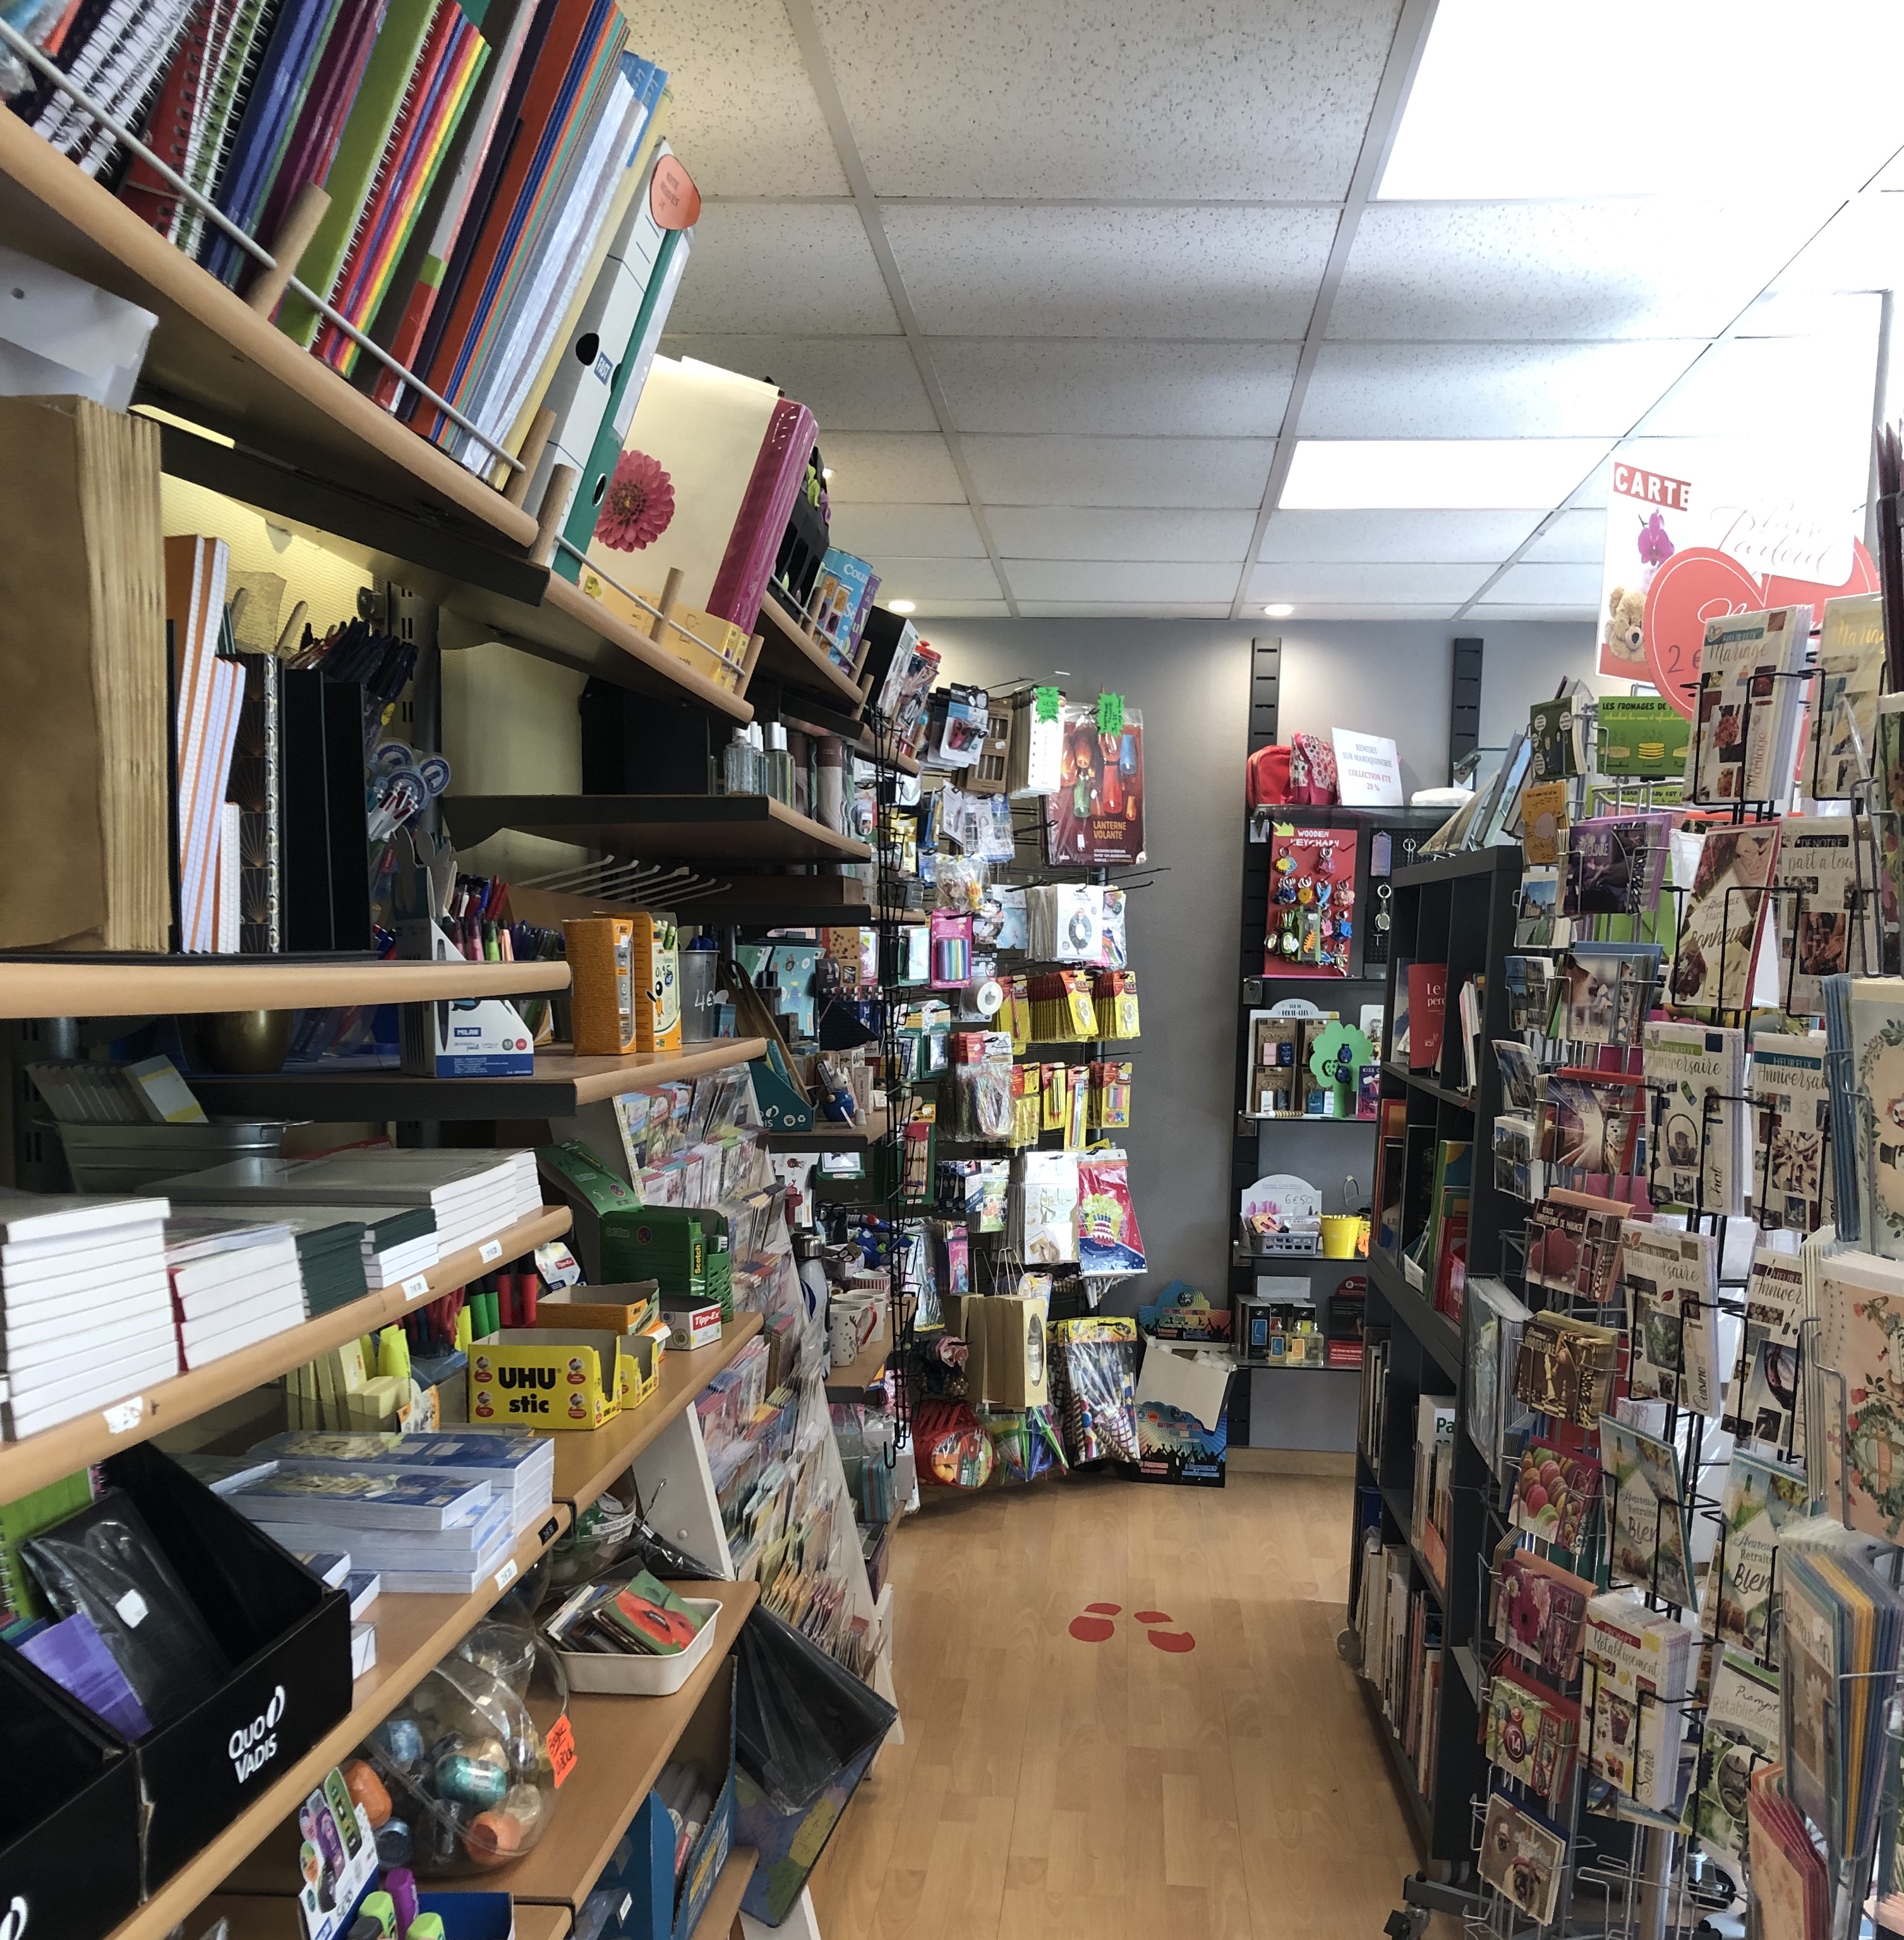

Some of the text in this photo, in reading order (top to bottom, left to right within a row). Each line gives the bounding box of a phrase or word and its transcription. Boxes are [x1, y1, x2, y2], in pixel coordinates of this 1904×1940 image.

[598, 355, 611, 379] FAST
[1615, 466, 1691, 510] CARTE
[1668, 645, 1684, 673] 2
[1709, 642, 1768, 663] Mariage
[1356, 744, 1377, 754] REMISES
[1342, 752, 1392, 768] SUR MAROQUINERIE
[1746, 732, 1768, 788] Mariage
[1348, 769, 1381, 781] COLLECTION
[1094, 821, 1126, 830] LANTERNE
[1094, 830, 1123, 840] VOLANTE
[1290, 838, 1339, 847] KEYCHAIN
[1812, 838, 1843, 847] NOTRE
[1428, 984, 1441, 995] Le
[695, 989, 714, 1011] 4€
[1661, 1044, 1694, 1055] HEUREUX
[1773, 1057, 1813, 1069] HEUREUX
[1708, 1164, 1723, 1208] Chat
[1285, 1194, 1313, 1205] 6€50
[695, 1310, 720, 1326] Tipp-Ex
[498, 1367, 556, 1389] UHU
[1694, 1366, 1710, 1412] Cuisine
[509, 1394, 550, 1414] stic
[1436, 1417, 1453, 1433] Pa
[600, 1522, 620, 1531] SCOTCH
[1733, 1562, 1773, 1594] Bien
[228, 1716, 265, 1759] QUO
[234, 1733, 278, 1783] VADIS
